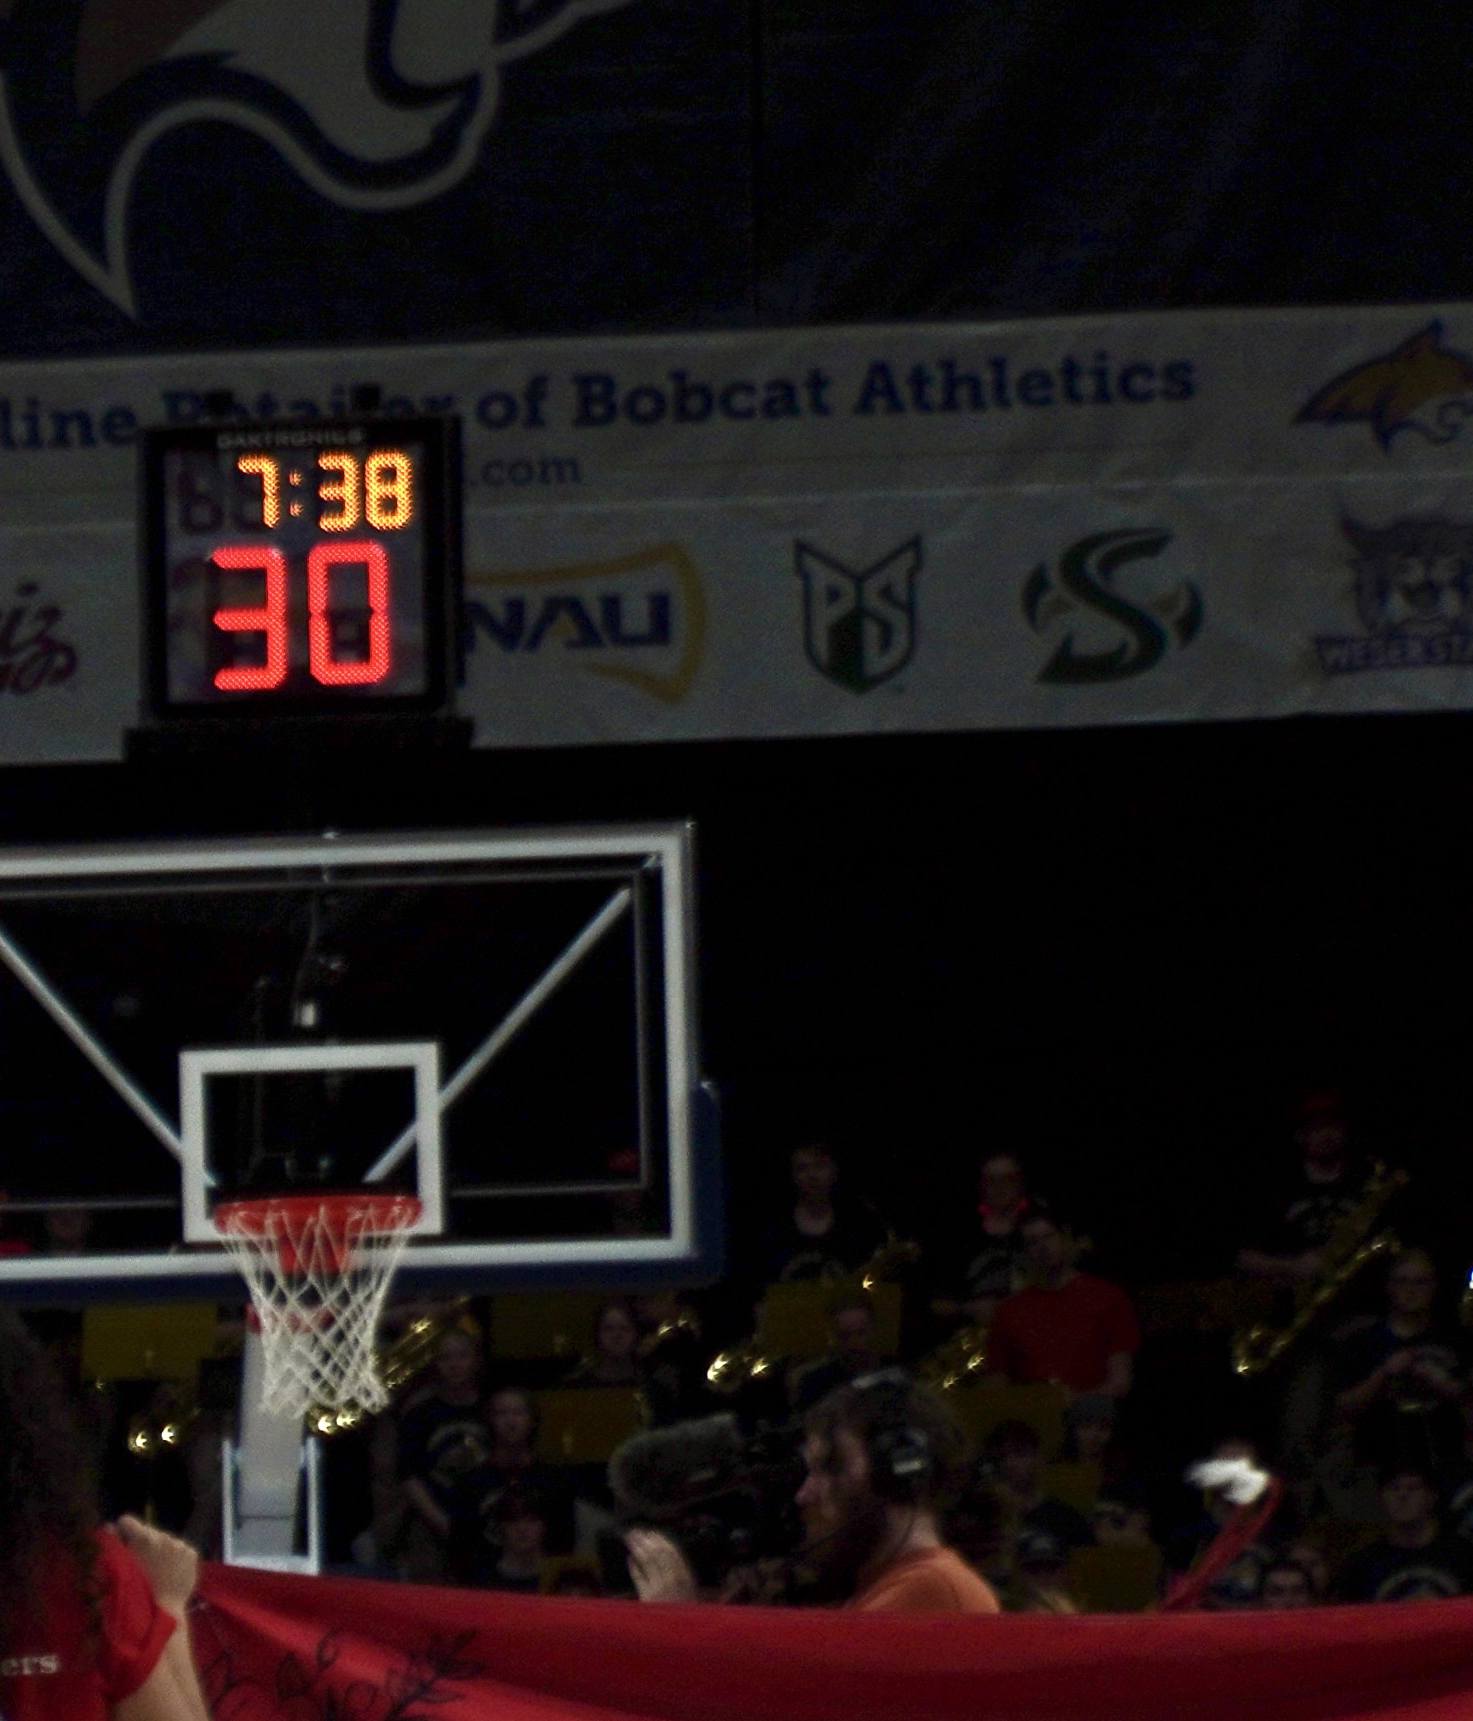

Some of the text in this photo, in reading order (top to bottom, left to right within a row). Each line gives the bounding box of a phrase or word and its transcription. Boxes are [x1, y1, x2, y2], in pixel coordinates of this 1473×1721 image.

[477, 375, 550, 429] of
[571, 368, 831, 427] Bobcat
[854, 352, 1196, 415] Athletics
[236, 450, 414, 533] 7:38
[211, 538, 392, 692] 30
[460, 591, 671, 652] NAU
